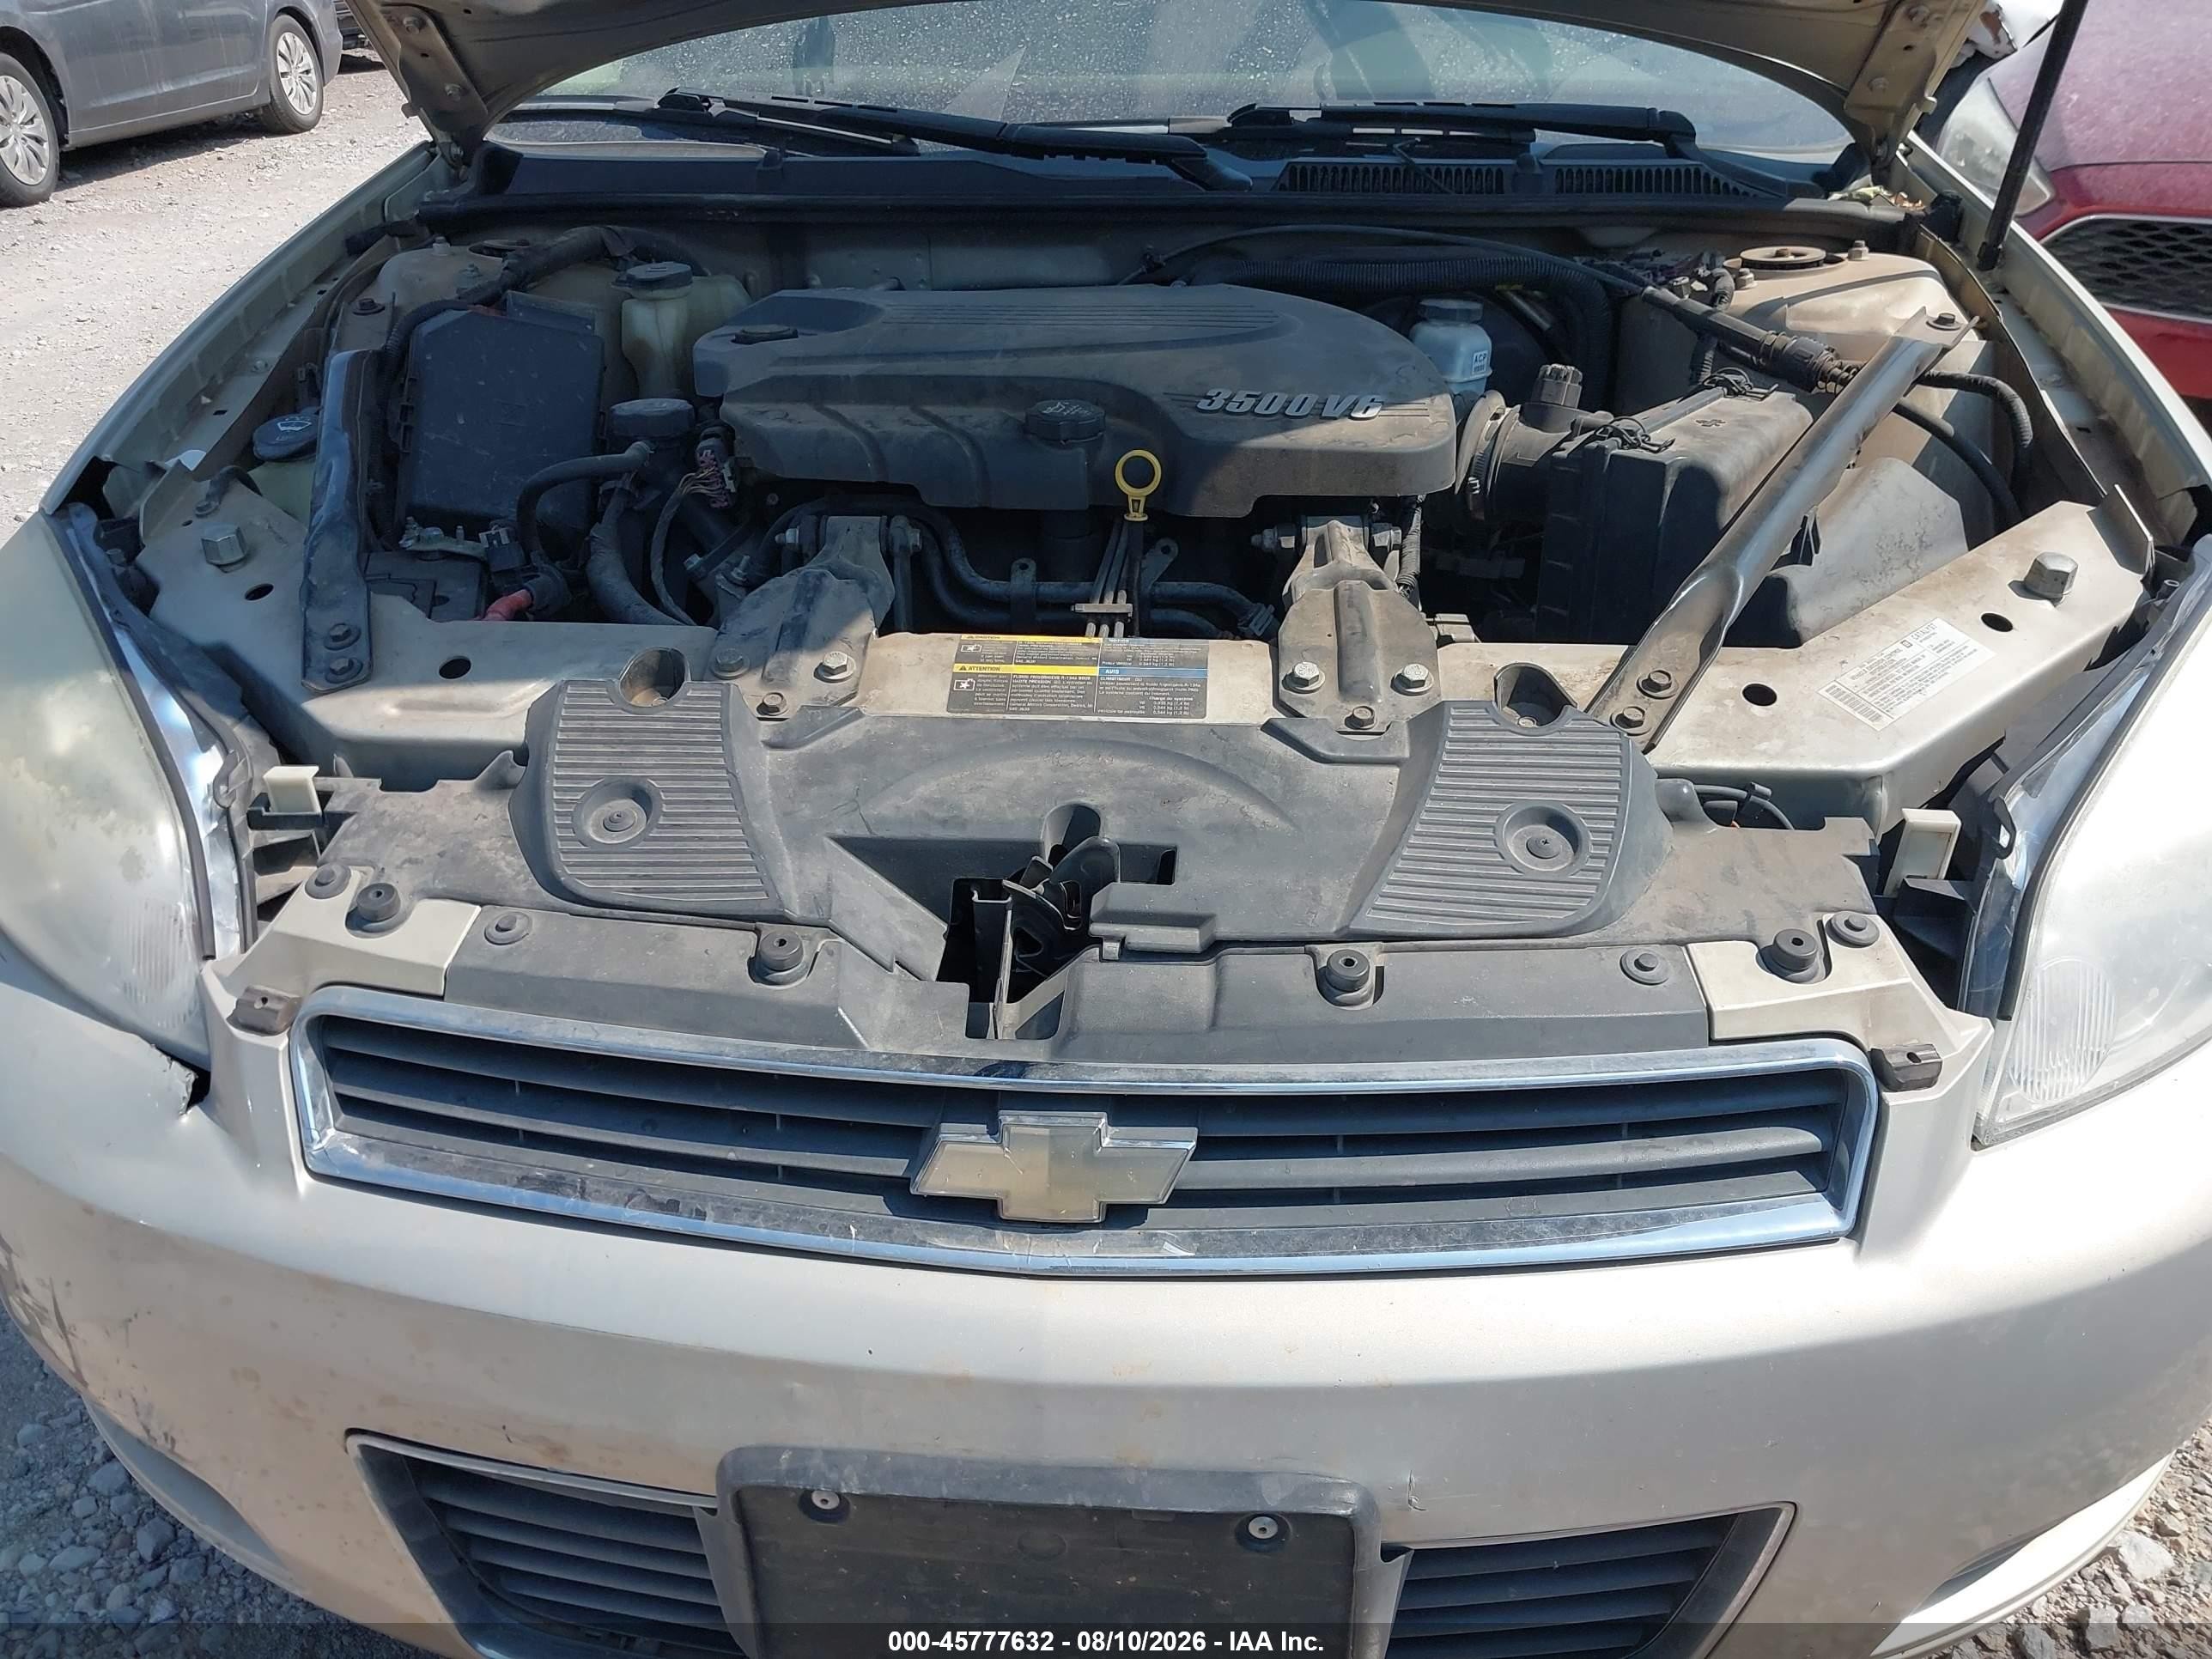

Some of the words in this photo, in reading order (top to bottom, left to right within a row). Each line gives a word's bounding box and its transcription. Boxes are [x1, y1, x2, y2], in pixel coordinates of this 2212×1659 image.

[1196, 388, 1319, 417] 3500
[1321, 393, 1384, 420] V6
[1911, 623, 1937, 641] CATALYST
